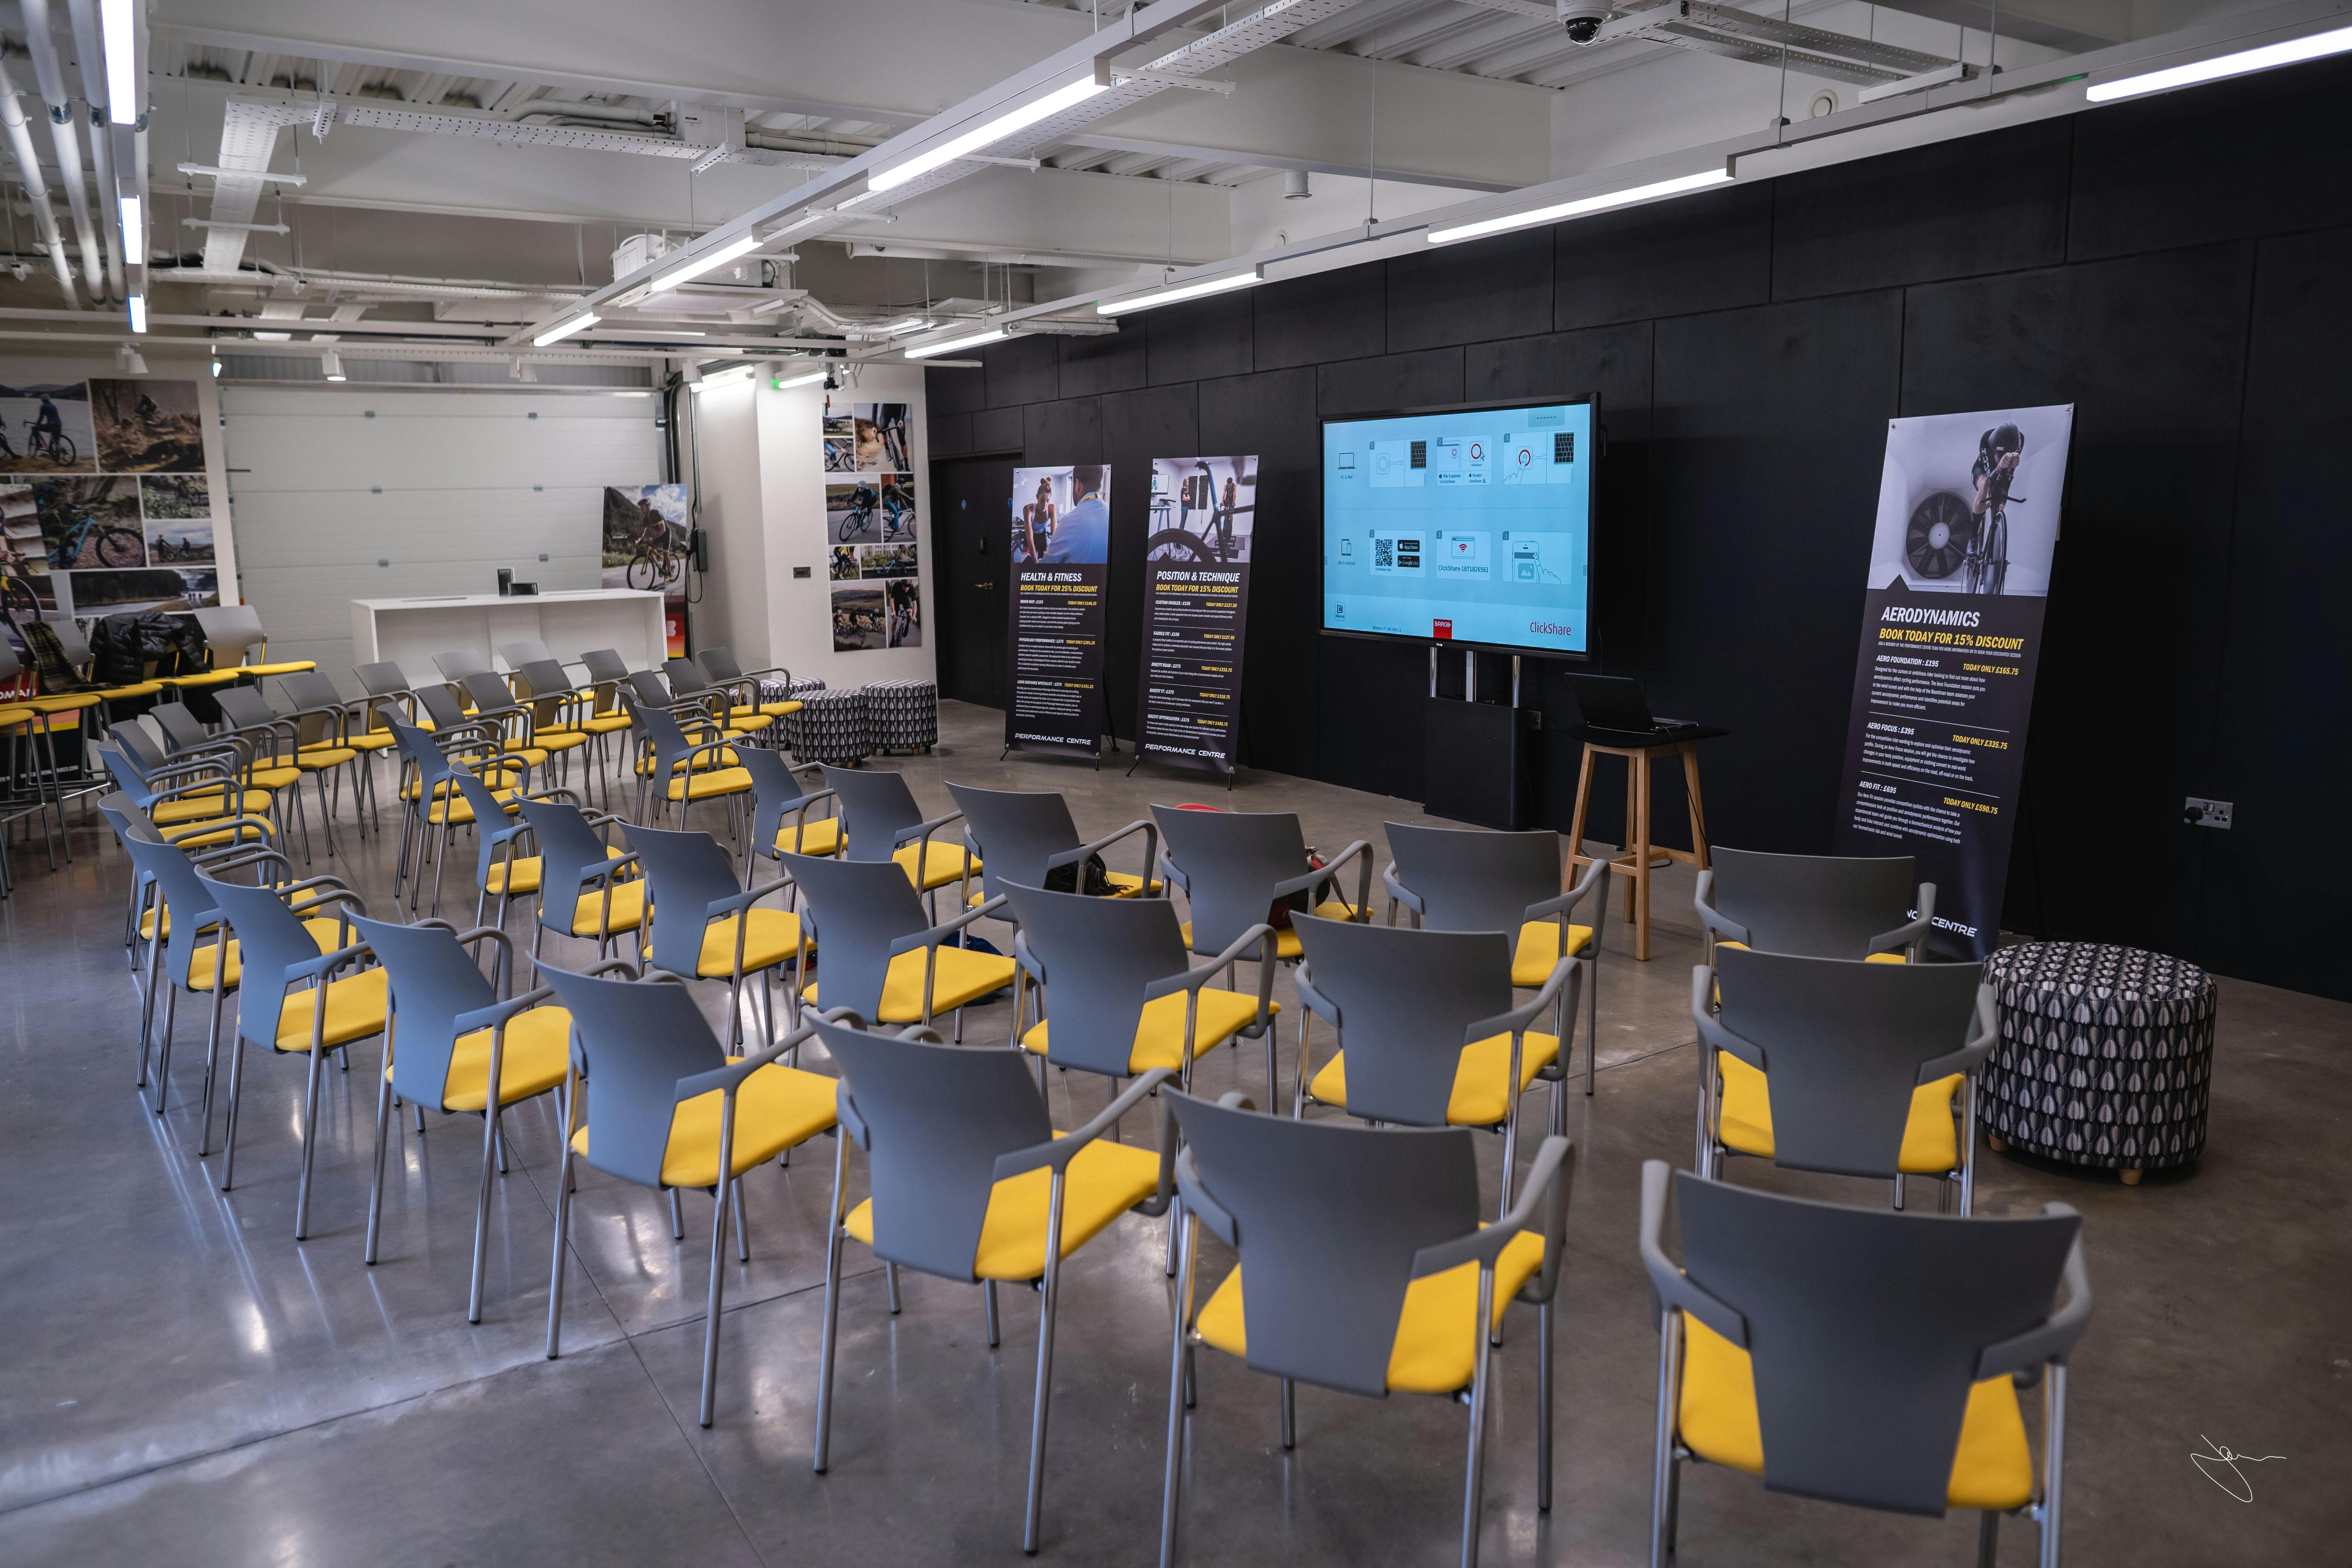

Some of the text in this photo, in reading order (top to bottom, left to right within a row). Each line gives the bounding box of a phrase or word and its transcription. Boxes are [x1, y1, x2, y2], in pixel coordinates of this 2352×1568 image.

[1021, 573, 1082, 582] HEALTH & FITNESS
[1157, 571, 1240, 583] POSITION & TECHNIQUE
[1881, 606, 1980, 627] AERODYNAMICS
[1530, 621, 1572, 636] ClickShare
[1879, 628, 2024, 650] BOOK TODAY FOR 15% DISCOUNT
[1890, 656, 1922, 665] FOUNDATION
[1995, 667, 2019, 675] £165.75
[1881, 724, 1897, 732] FOCUS
[1015, 733, 1064, 742] PERFORMANCE
[1953, 735, 1970, 743] TODAY
[1984, 740, 2008, 750] £335.75
[1145, 744, 1225, 759] PERFORMANCE CENTRE
[1944, 797, 1998, 814] TODAY ONLY £590.75
[1931, 916, 1978, 937] CENTRE
